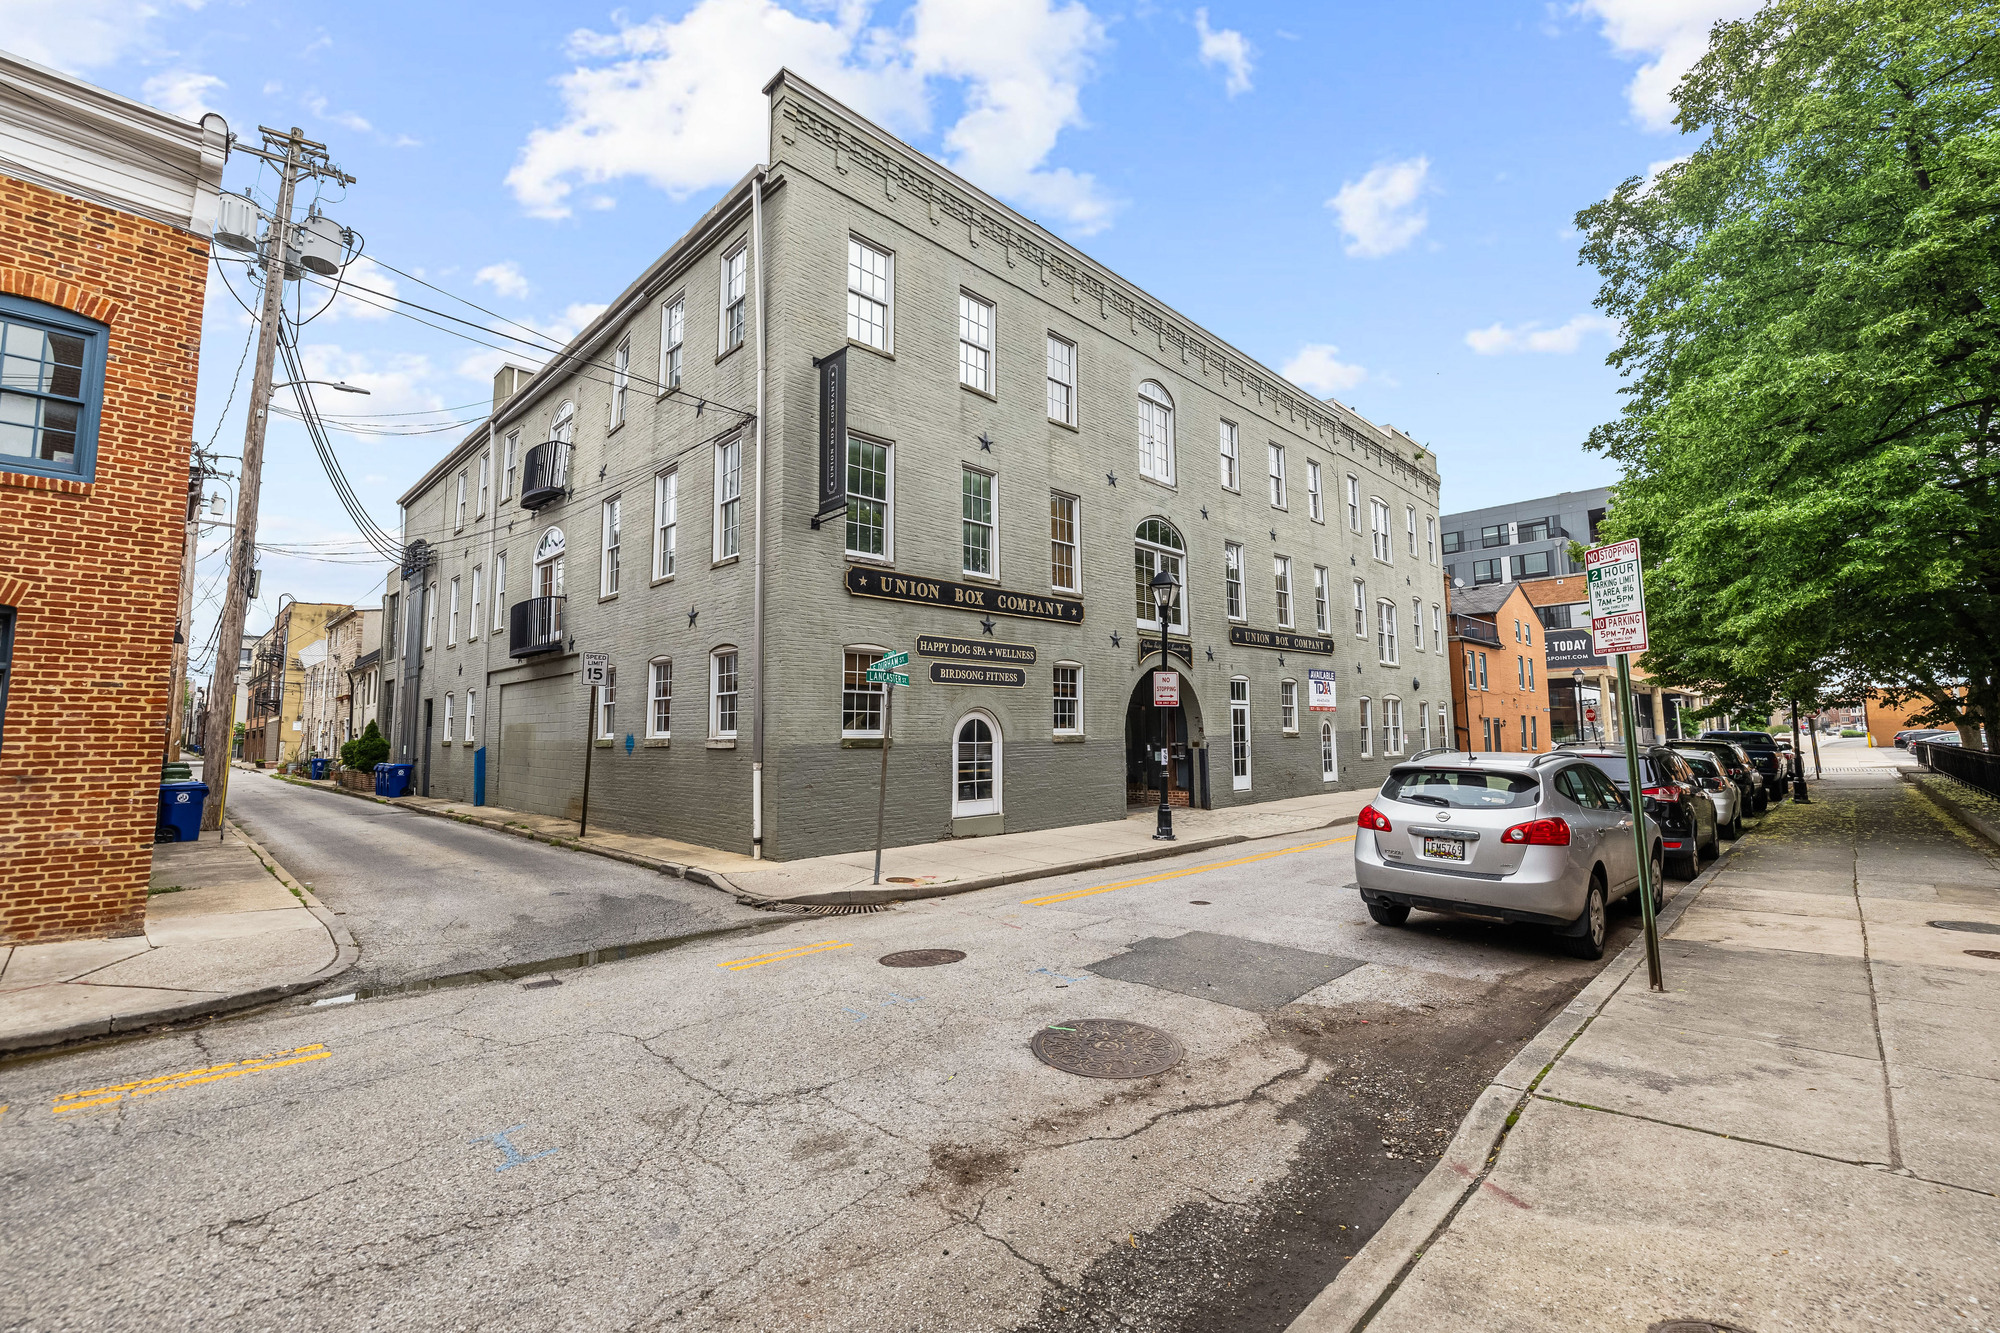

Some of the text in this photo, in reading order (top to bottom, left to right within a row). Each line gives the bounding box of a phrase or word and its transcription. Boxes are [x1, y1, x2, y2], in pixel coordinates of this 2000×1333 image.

[1587, 543, 1635, 564] NO STOPPING
[1591, 563, 1634, 581] 2 HOUR
[1592, 574, 1635, 590] PARKING LIMIT
[880, 576, 1064, 616] UNION BOX COMPANY
[1595, 584, 1634, 599] IN AREA #16
[1597, 594, 1634, 607] 7AM-5PM
[1594, 614, 1640, 629] NO PARKING
[1244, 631, 1324, 650] UNION BOX COMPANY
[1600, 627, 1637, 639] 5PM-7AM
[919, 640, 950, 653] HAPPY
[951, 643, 971, 655] DOG
[972, 645, 987, 656] SPA
[995, 647, 1035, 660] WELLNESS
[1552, 639, 1587, 652] TODAY
[877, 656, 899, 670] DURHAM
[1546, 654, 1589, 662] SPOINT.COM
[587, 667, 603, 680] 15
[869, 672, 902, 684] LANCASTER
[939, 668, 1018, 683] BIRDSONG FITNESS
[1310, 670, 1335, 681] AVAILABLE
